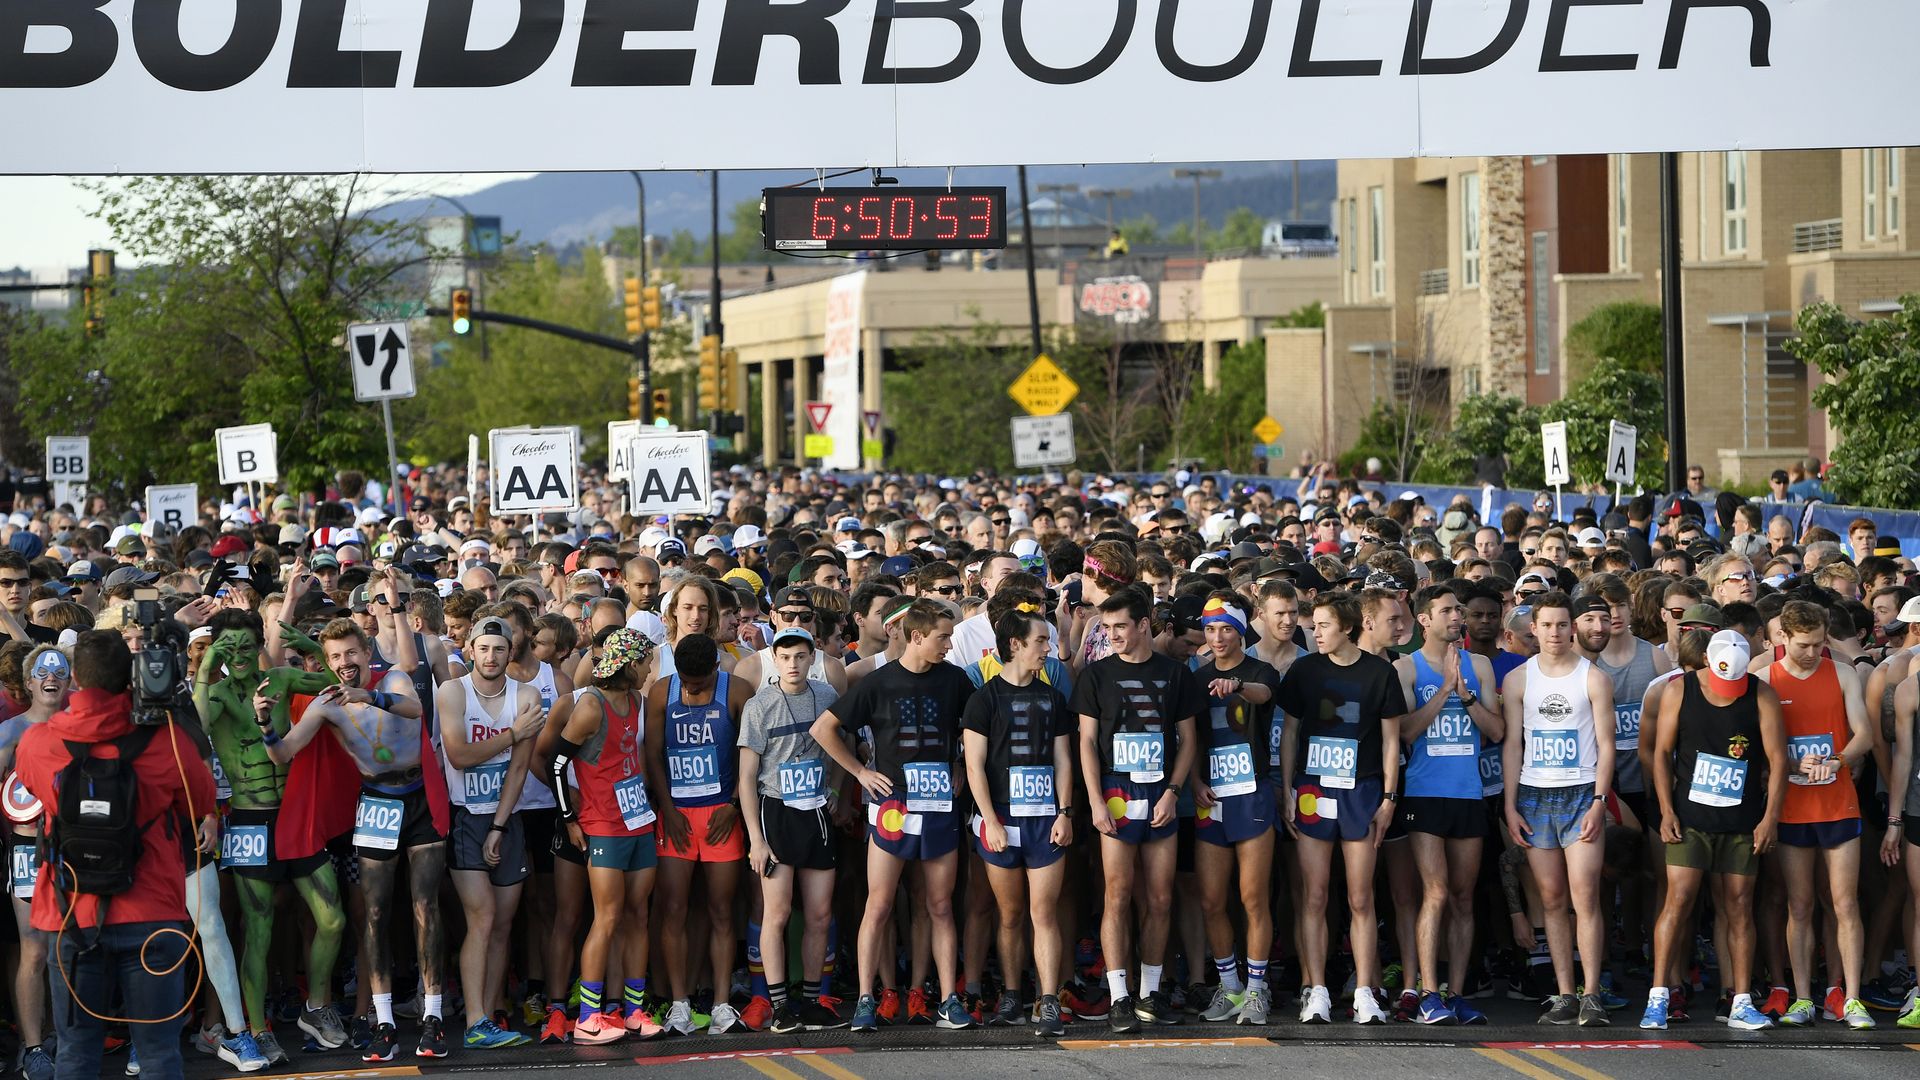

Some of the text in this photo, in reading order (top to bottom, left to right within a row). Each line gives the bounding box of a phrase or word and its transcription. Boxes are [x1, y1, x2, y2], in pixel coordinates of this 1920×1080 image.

[53, 457, 84, 475] BB
[237, 450, 257, 473] B
[1551, 446, 1562, 476] A
[1614, 445, 1627, 477] A
[503, 464, 569, 501] AA
[639, 467, 702, 504] AA
[164, 509, 183, 530] B
[676, 722, 715, 744] USA
[1427, 714, 1472, 738] A612
[1113, 740, 1162, 765] A042
[1308, 743, 1355, 770] A038
[1532, 736, 1577, 762] A509
[668, 754, 714, 781] A501
[1209, 752, 1252, 780] A598
[1692, 759, 1745, 791] A545
[465, 771, 508, 797] A04
[780, 766, 824, 794] A247
[905, 768, 951, 793] A553
[1010, 773, 1052, 798] A569
[356, 802, 401, 831] A402
[222, 833, 265, 858] A290
